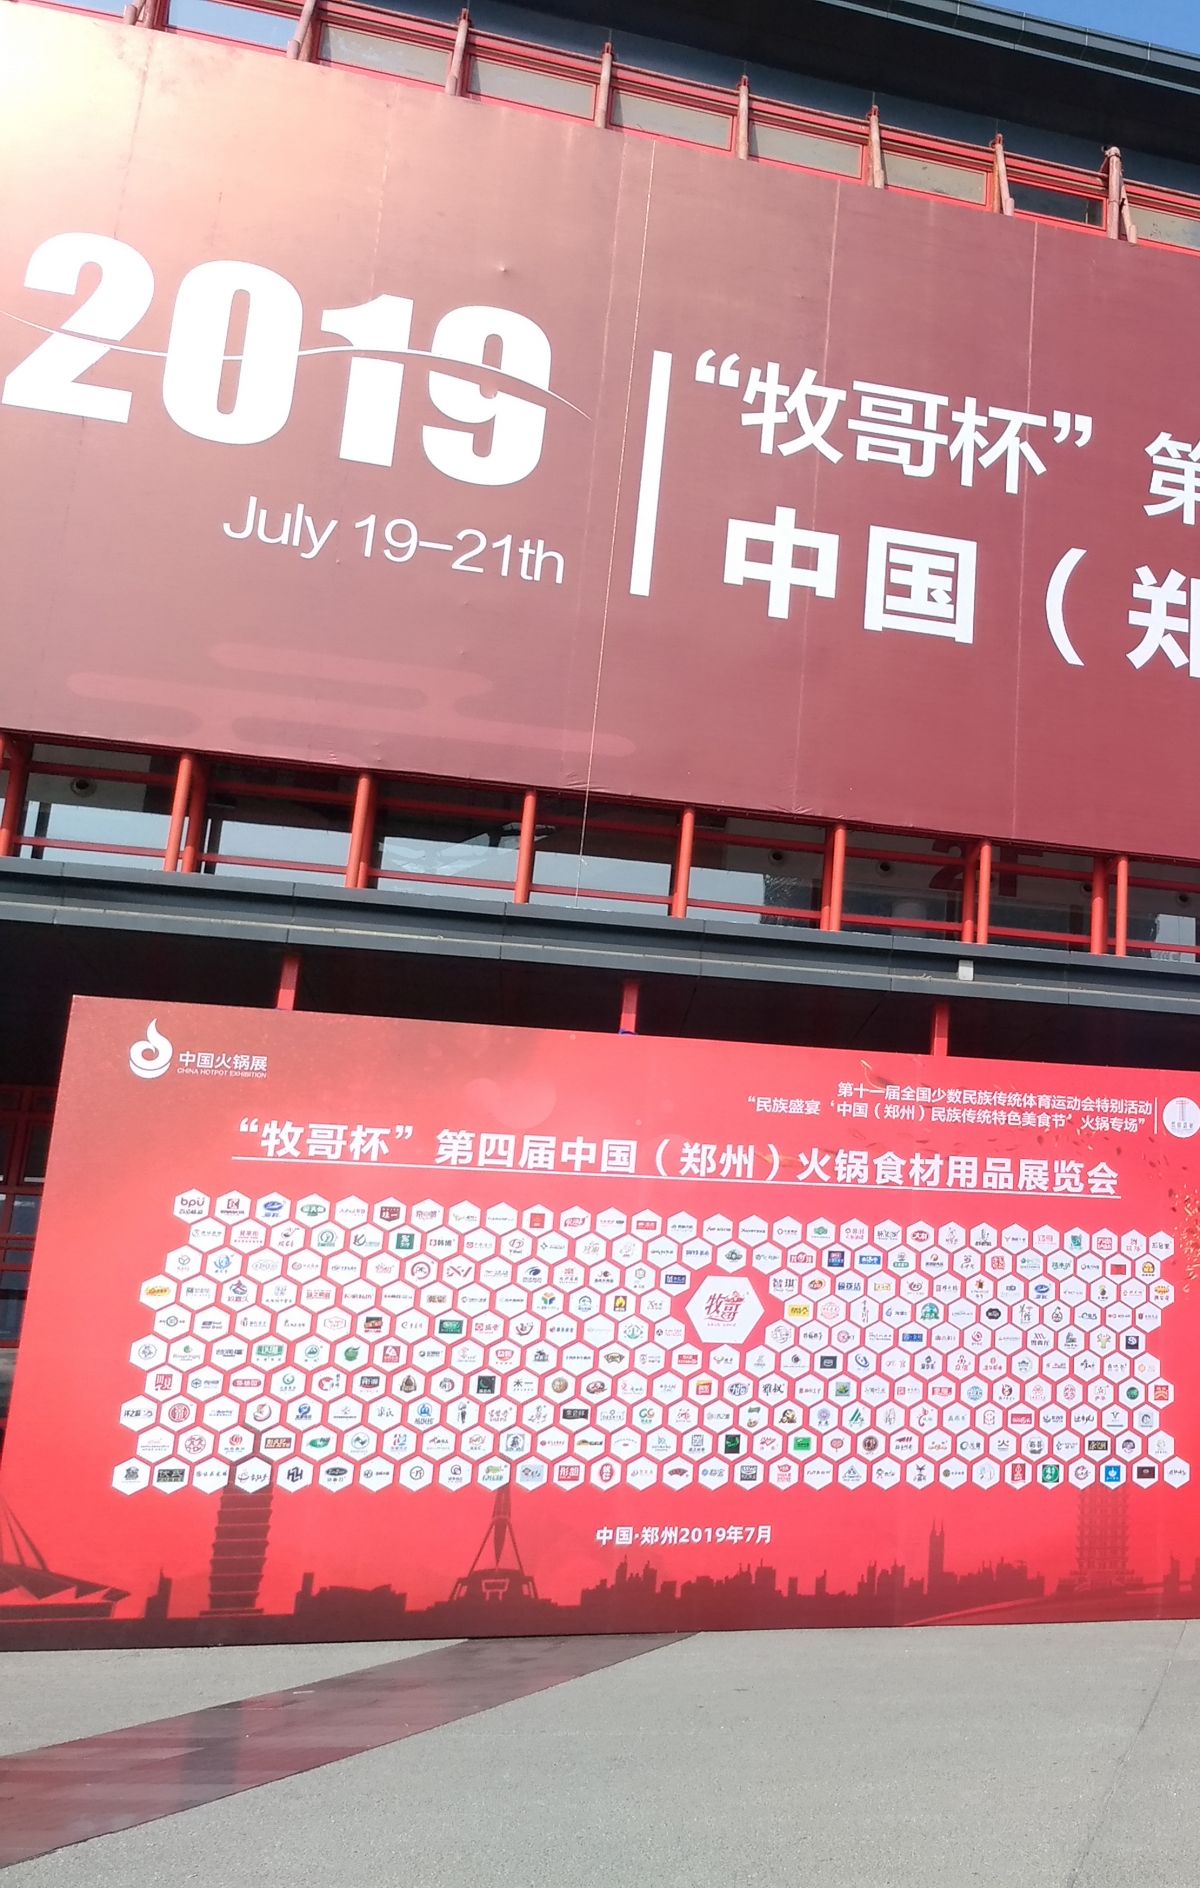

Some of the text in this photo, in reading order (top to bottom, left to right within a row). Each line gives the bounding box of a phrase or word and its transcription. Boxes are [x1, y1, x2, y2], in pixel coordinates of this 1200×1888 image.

[2, 232, 552, 485] 2019
[695, 348, 1093, 495] “牧哥杯”
[223, 496, 338, 559] July
[178, 1050, 268, 1071] 中国火锅展
[837, 1081, 1152, 1116] 第十一届全国少数民族传统体育运动会特别活动
[239, 1116, 414, 1162] “牧哥杯”
[595, 1525, 773, 1546] 中国·郑州2019年7月
